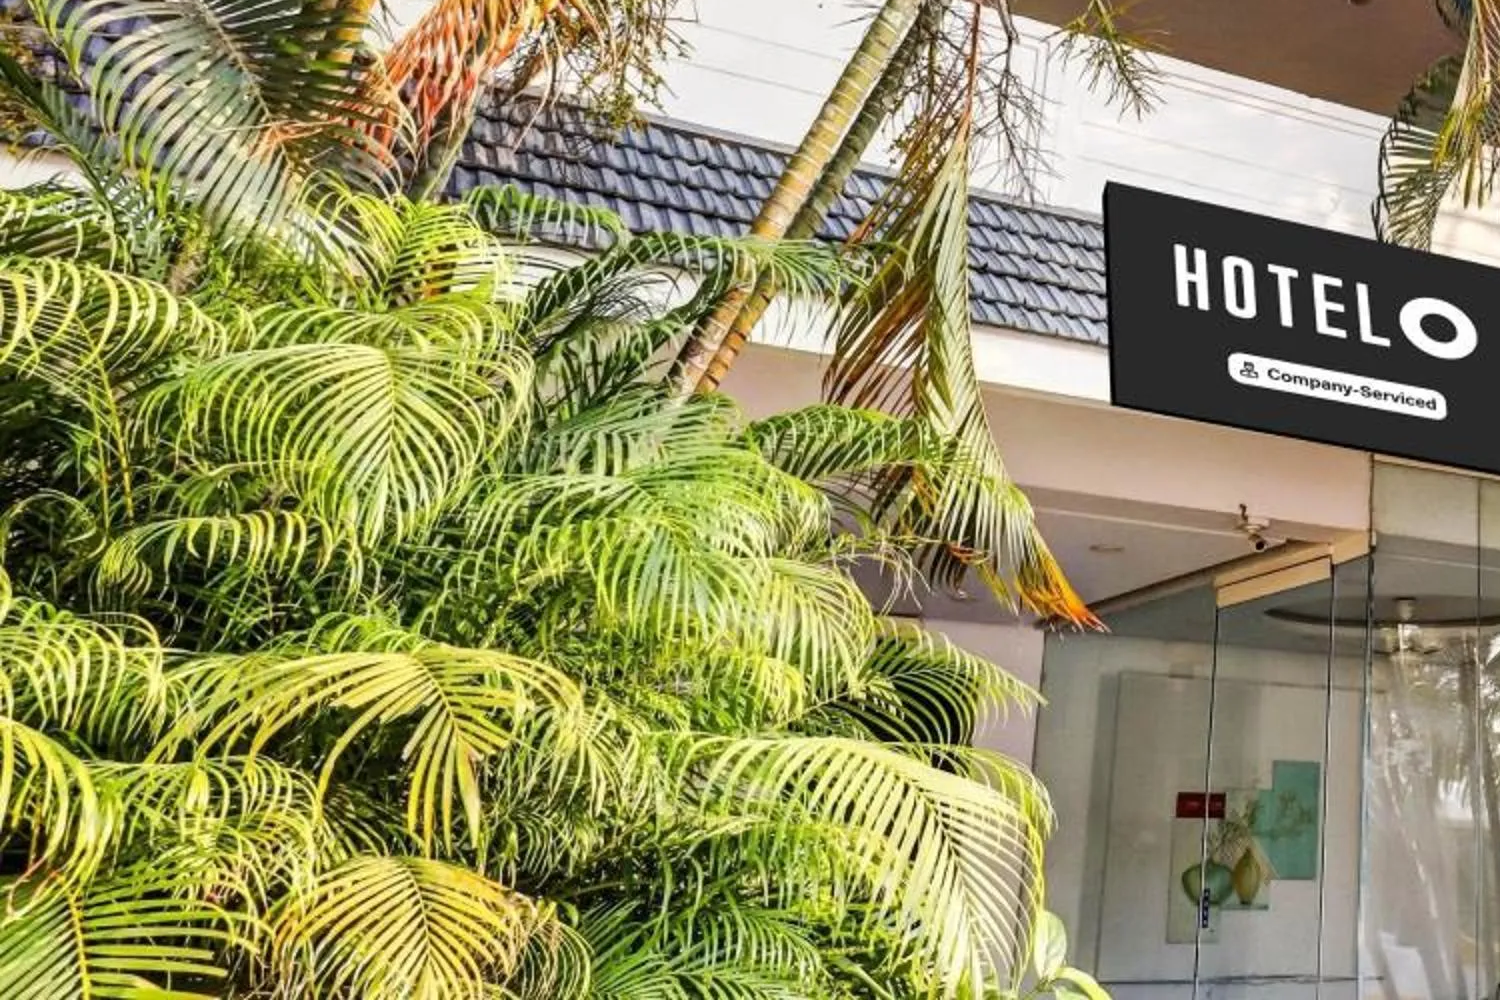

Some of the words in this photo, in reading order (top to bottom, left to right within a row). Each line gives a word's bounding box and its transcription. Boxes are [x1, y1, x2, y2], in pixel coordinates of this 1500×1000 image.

[1173, 243, 1391, 348] HOTEL
[1399, 297, 1478, 360] O
[1267, 367, 1437, 411] Company-Serviced
